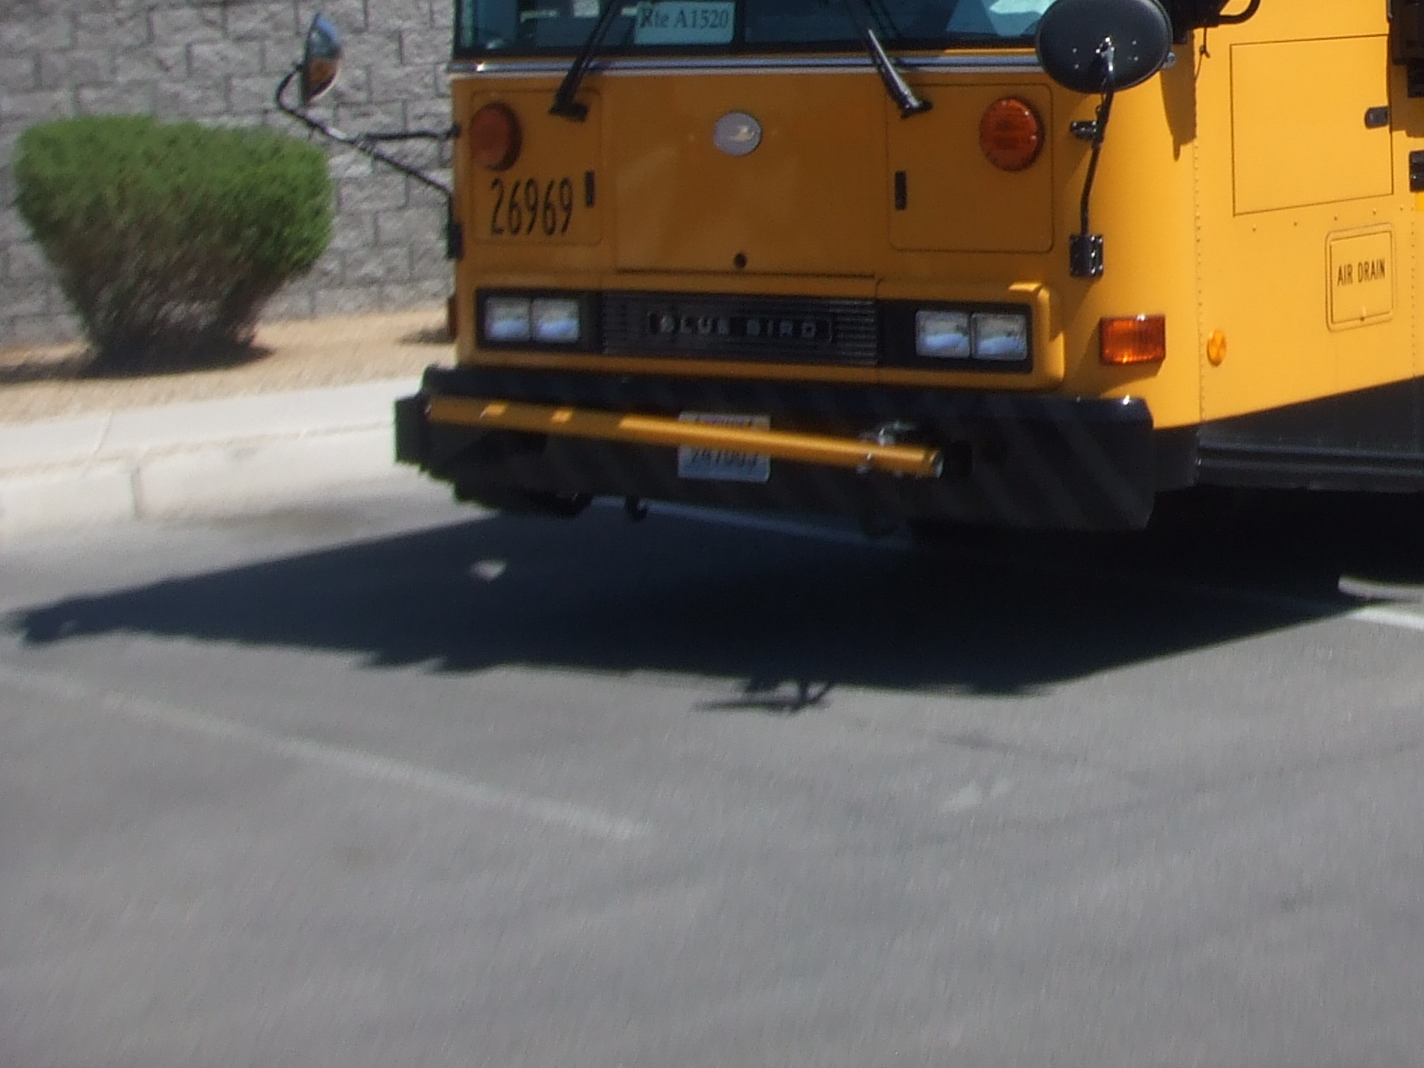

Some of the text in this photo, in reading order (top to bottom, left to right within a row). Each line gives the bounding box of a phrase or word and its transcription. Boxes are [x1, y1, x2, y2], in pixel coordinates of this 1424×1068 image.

[674, 8, 729, 29] A1520
[490, 177, 574, 236] 26969
[1336, 258, 1386, 286] AIR DRAIN
[660, 315, 816, 340] BLUE BIRD
